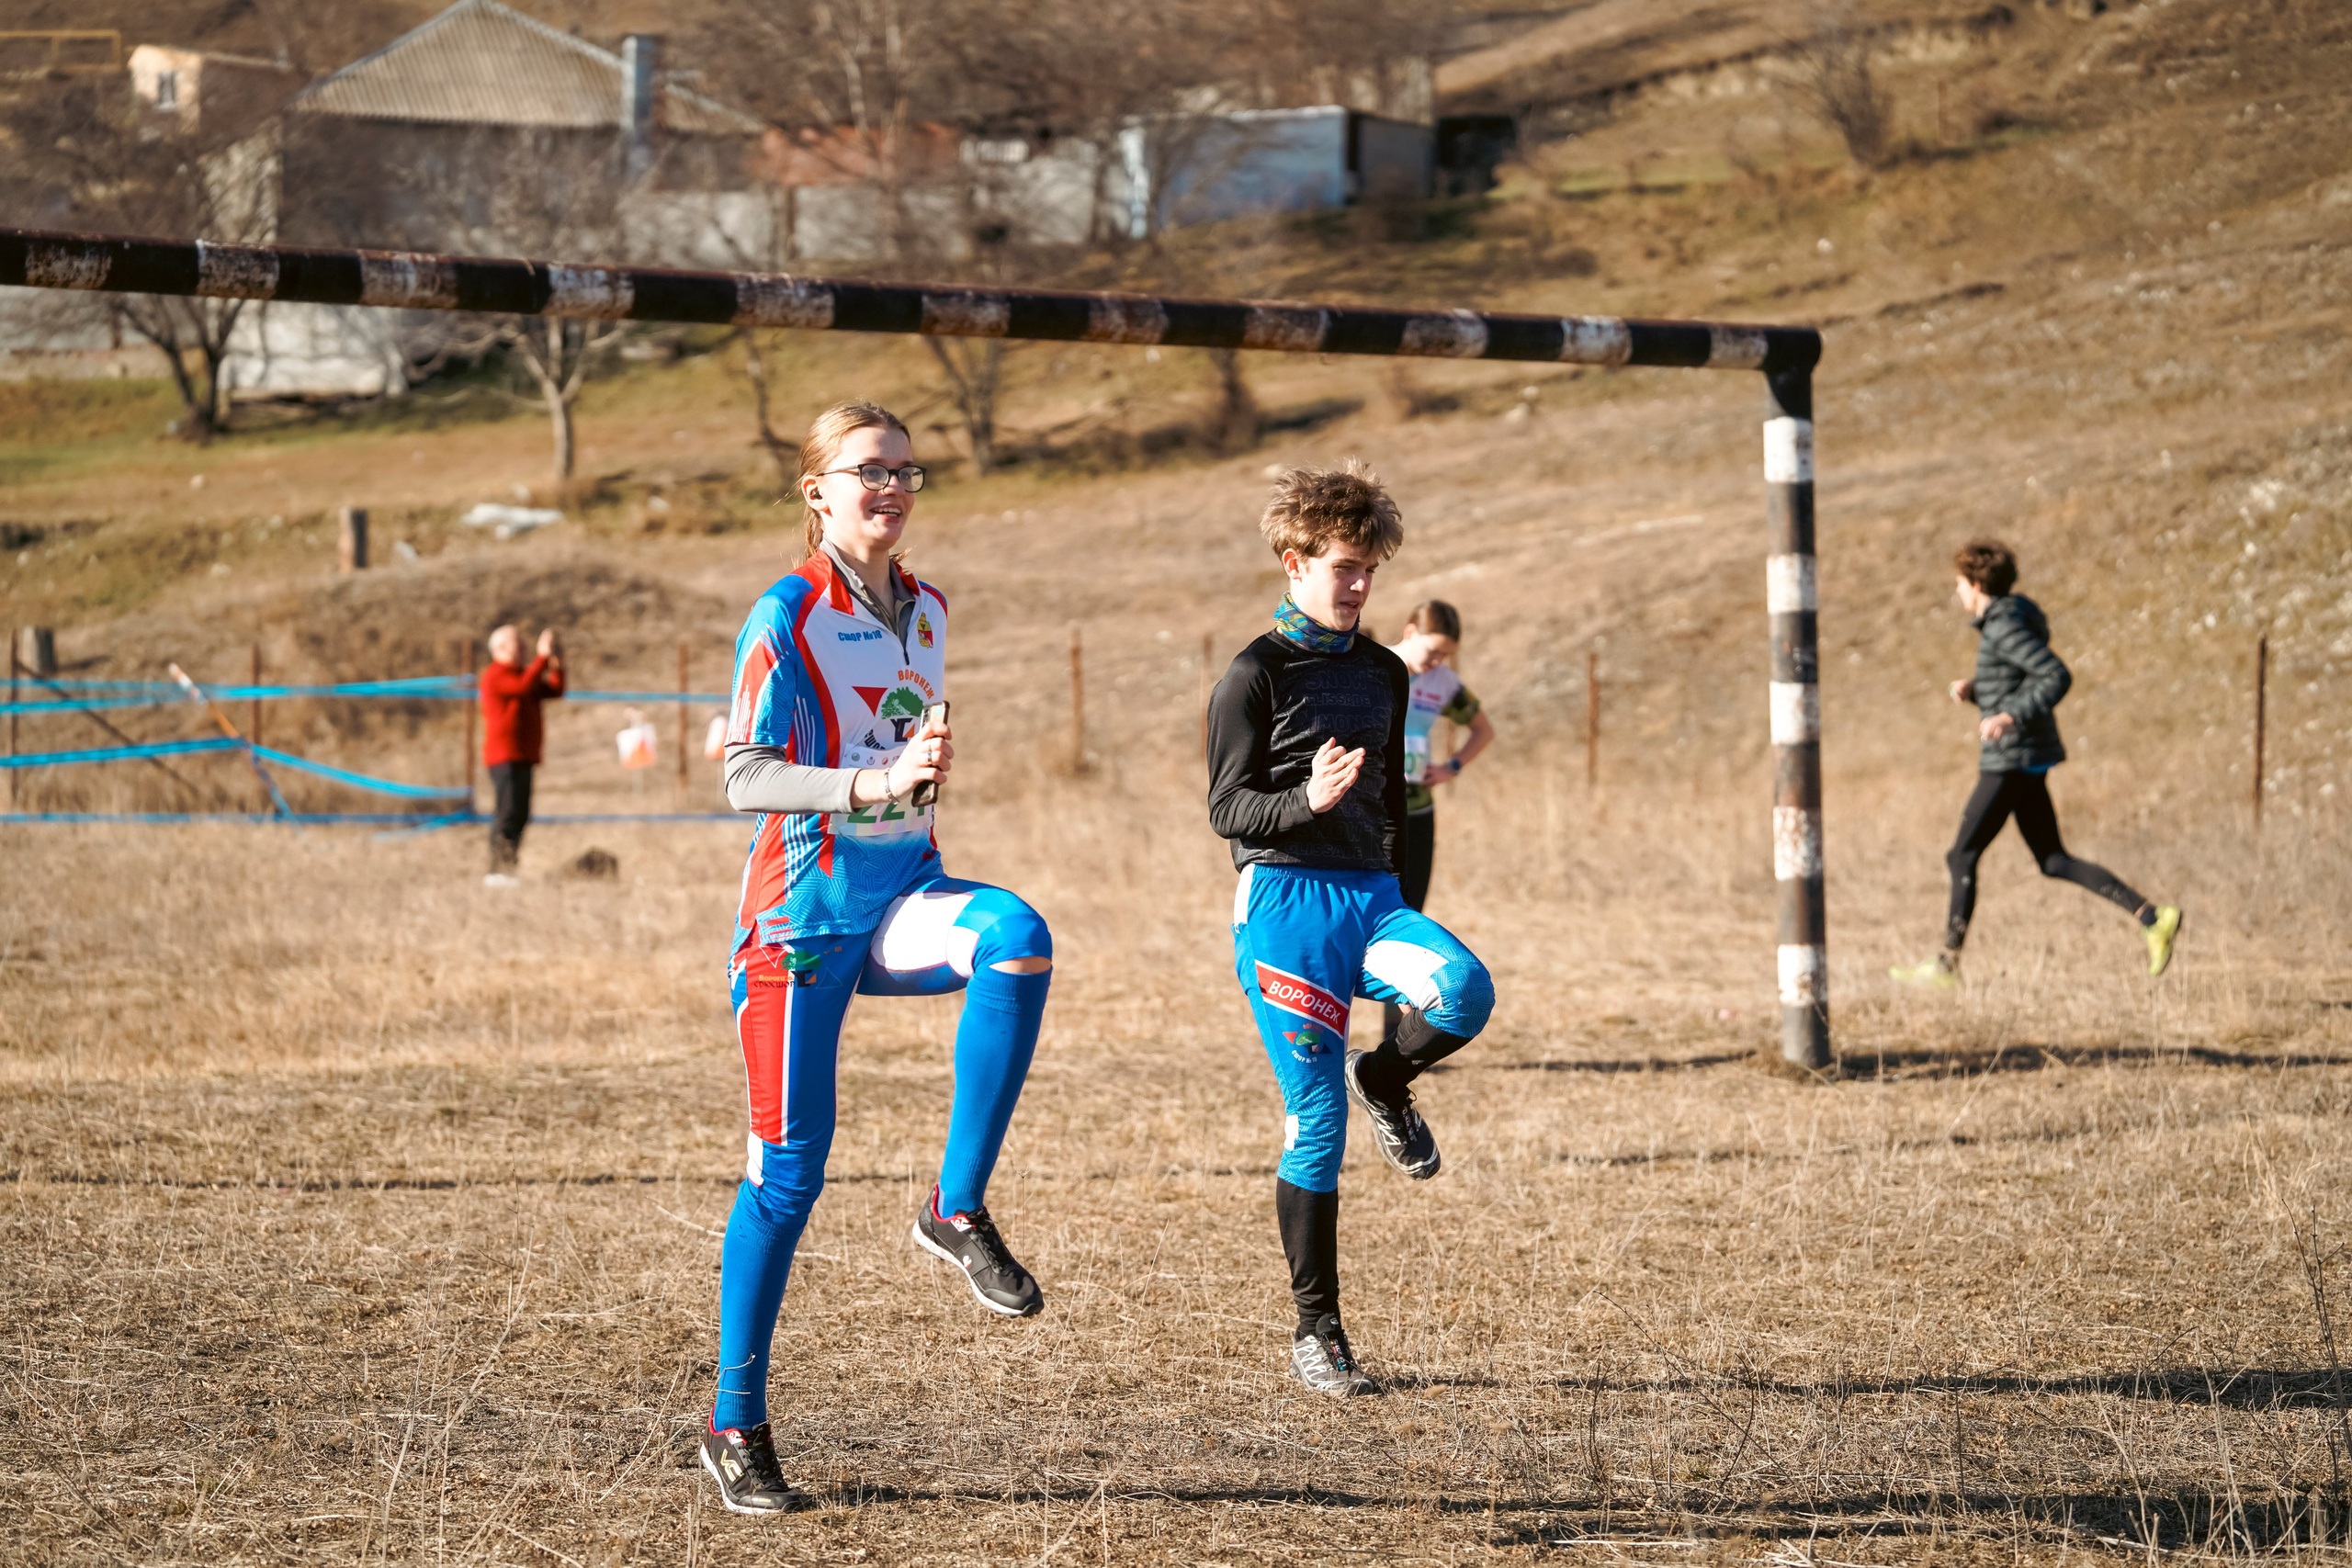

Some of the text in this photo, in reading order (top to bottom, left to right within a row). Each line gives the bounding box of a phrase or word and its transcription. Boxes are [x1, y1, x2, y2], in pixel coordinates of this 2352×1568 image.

[898, 669, 934, 700] ВОРОНЕЖ
[1304, 670, 1367, 690] SNOW
[1304, 693, 1372, 707] GLISSADE
[1268, 980, 1341, 1024] ВОРОНЕЖ
